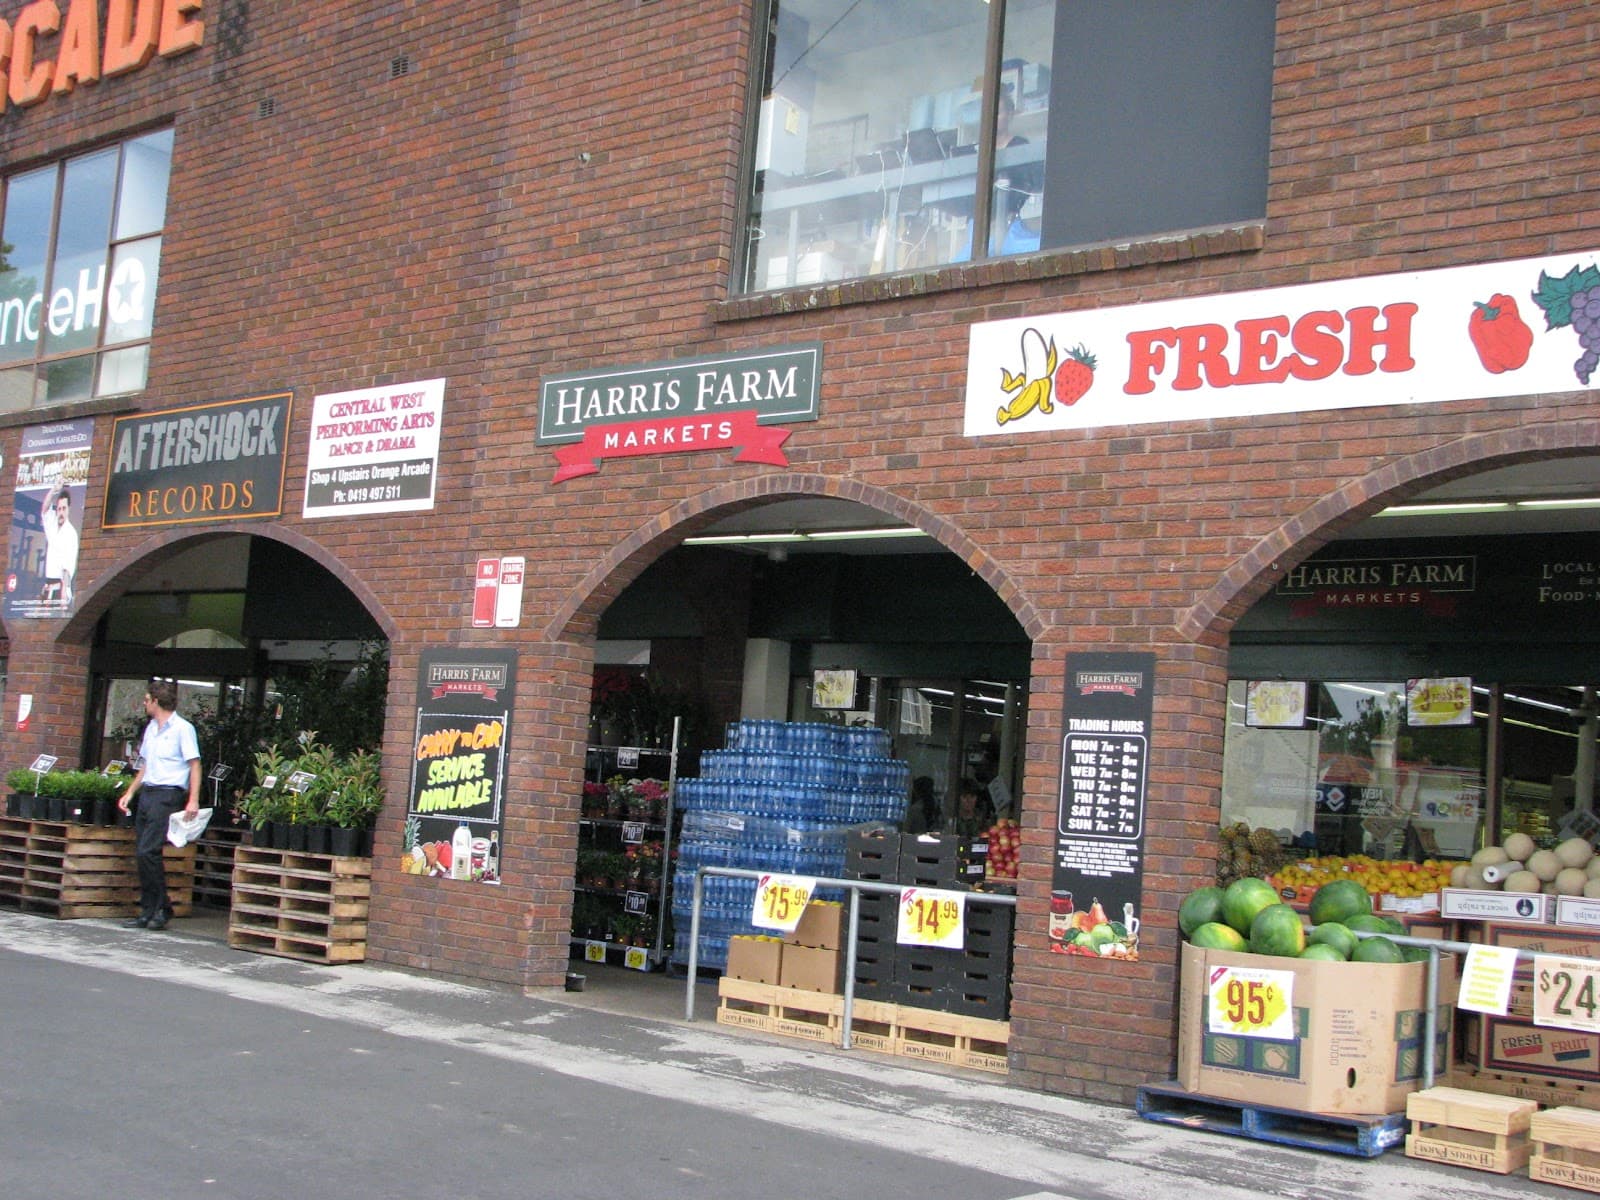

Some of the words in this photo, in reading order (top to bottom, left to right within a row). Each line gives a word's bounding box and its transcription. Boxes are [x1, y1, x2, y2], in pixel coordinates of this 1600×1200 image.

[0, 0, 204, 114] CADE
[0, 257, 145, 345] nceHQ
[1122, 302, 1419, 396] FRESH
[329, 397, 386, 418] CENTRAL
[389, 391, 426, 409] WEST
[554, 379, 681, 426] HARRIS
[694, 366, 798, 412] FARM
[316, 416, 398, 440] PERFORMING
[400, 412, 435, 430] ARTS
[604, 421, 733, 449] MARKETS
[113, 406, 281, 473] AFTERSHOCK
[329, 441, 363, 457] DANCE
[365, 440, 374, 453] &
[376, 436, 416, 452] DRAMA
[311, 471, 330, 486] Shop
[331, 470, 337, 482] 4
[338, 468, 370, 484] Upstairs
[371, 466, 400, 480] Orange
[401, 462, 431, 476] Arcade
[128, 479, 254, 518] RECORDS
[347, 488, 368, 502] 0419
[369, 486, 385, 500] 497
[386, 485, 401, 498] 511
[1286, 565, 1381, 588] HARRIS
[1392, 563, 1466, 586] FARM
[1543, 562, 1596, 579] LOCAL
[1326, 592, 1421, 603] MARKETS
[1538, 586, 1585, 602] FOOD
[432, 667, 469, 682] HARRIS
[471, 667, 501, 681] FARM
[1080, 674, 1111, 684] HARRIS
[1113, 674, 1138, 684] FARM
[447, 683, 483, 692] MARKETS
[1069, 718, 1110, 731] TRADING
[1111, 720, 1144, 733] HOURS
[416, 728, 462, 761] CARRY
[471, 720, 503, 752] CAR
[1071, 739, 1098, 751] MON
[1074, 753, 1096, 764] TUE
[427, 753, 486, 786] SERVICE
[1070, 766, 1096, 777] WED
[1072, 779, 1095, 790] THU
[417, 778, 493, 813] AVAILABLE
[1074, 792, 1093, 803] FRI
[1071, 805, 1092, 817] SAT
[1068, 818, 1092, 830] SUN
[762, 886, 808, 920] $15.99
[906, 898, 959, 934] $14.99
[1501, 1033, 1543, 1049] FRESH
[1551, 1037, 1589, 1052] FRUIT
[1420, 1146, 1450, 1159] FARM
[1450, 1150, 1489, 1165] HARRIS
[1545, 1166, 1576, 1181] FARM
